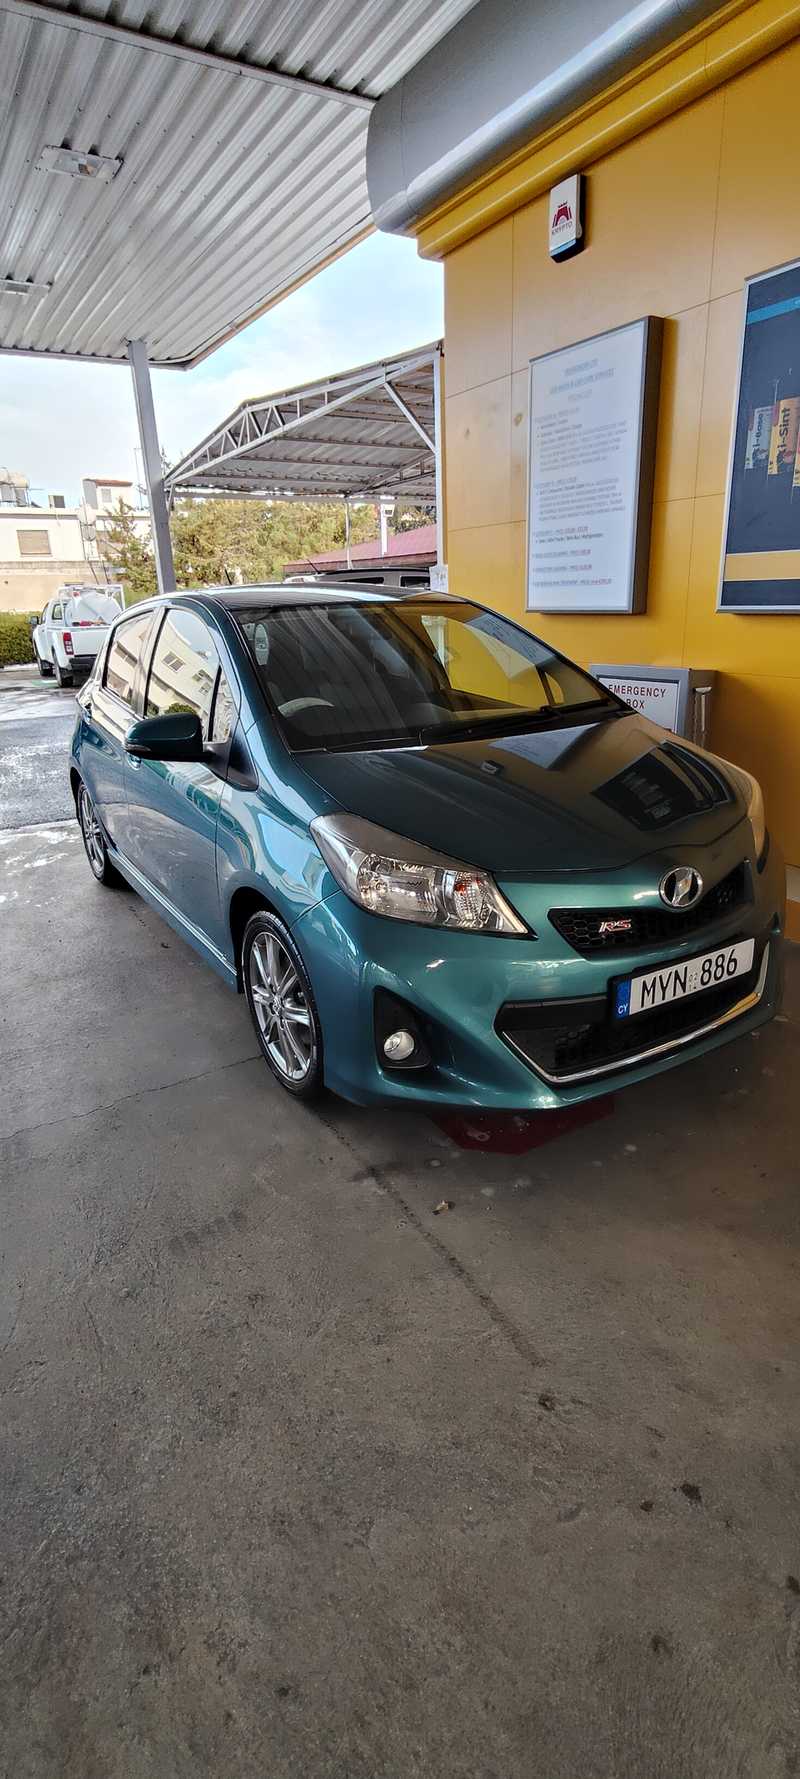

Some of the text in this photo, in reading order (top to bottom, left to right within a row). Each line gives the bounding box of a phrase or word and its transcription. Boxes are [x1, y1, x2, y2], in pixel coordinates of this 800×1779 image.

[608, 684, 666, 698] EMERGENCY
[640, 949, 738, 1008] MYN 886
[617, 1003, 629, 1015] CY
